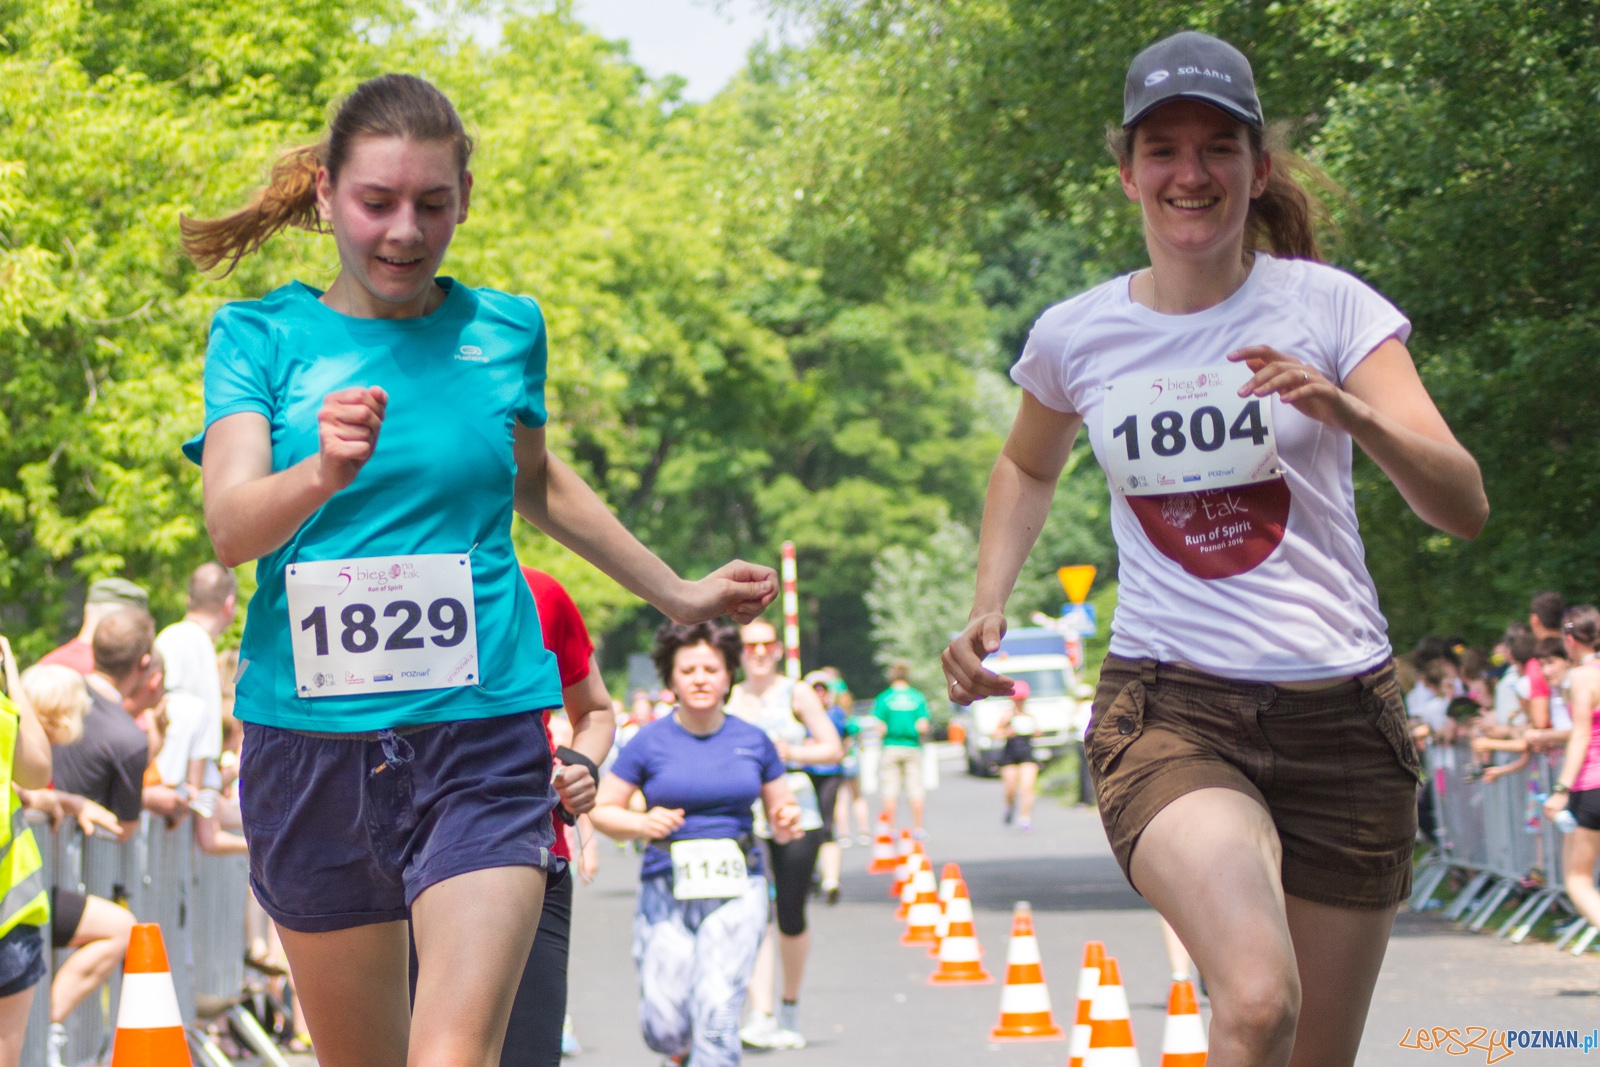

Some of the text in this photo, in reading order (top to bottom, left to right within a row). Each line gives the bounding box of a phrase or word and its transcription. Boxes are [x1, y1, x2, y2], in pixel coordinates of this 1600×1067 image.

[1177, 66, 1232, 83] SOLARIS
[1149, 378, 1163, 405] 5
[1167, 378, 1195, 394] bieg
[1194, 391, 1208, 400] Spirit
[1113, 400, 1269, 461] 1804
[1201, 492, 1249, 520] tak
[1184, 520, 1252, 546] Run of Spirit
[1227, 537, 1244, 548] 2016
[337, 562, 420, 596] 5 bieg na tak
[387, 584, 403, 592] Spirit
[301, 597, 469, 656] 1829
[679, 859, 742, 880] 1149
